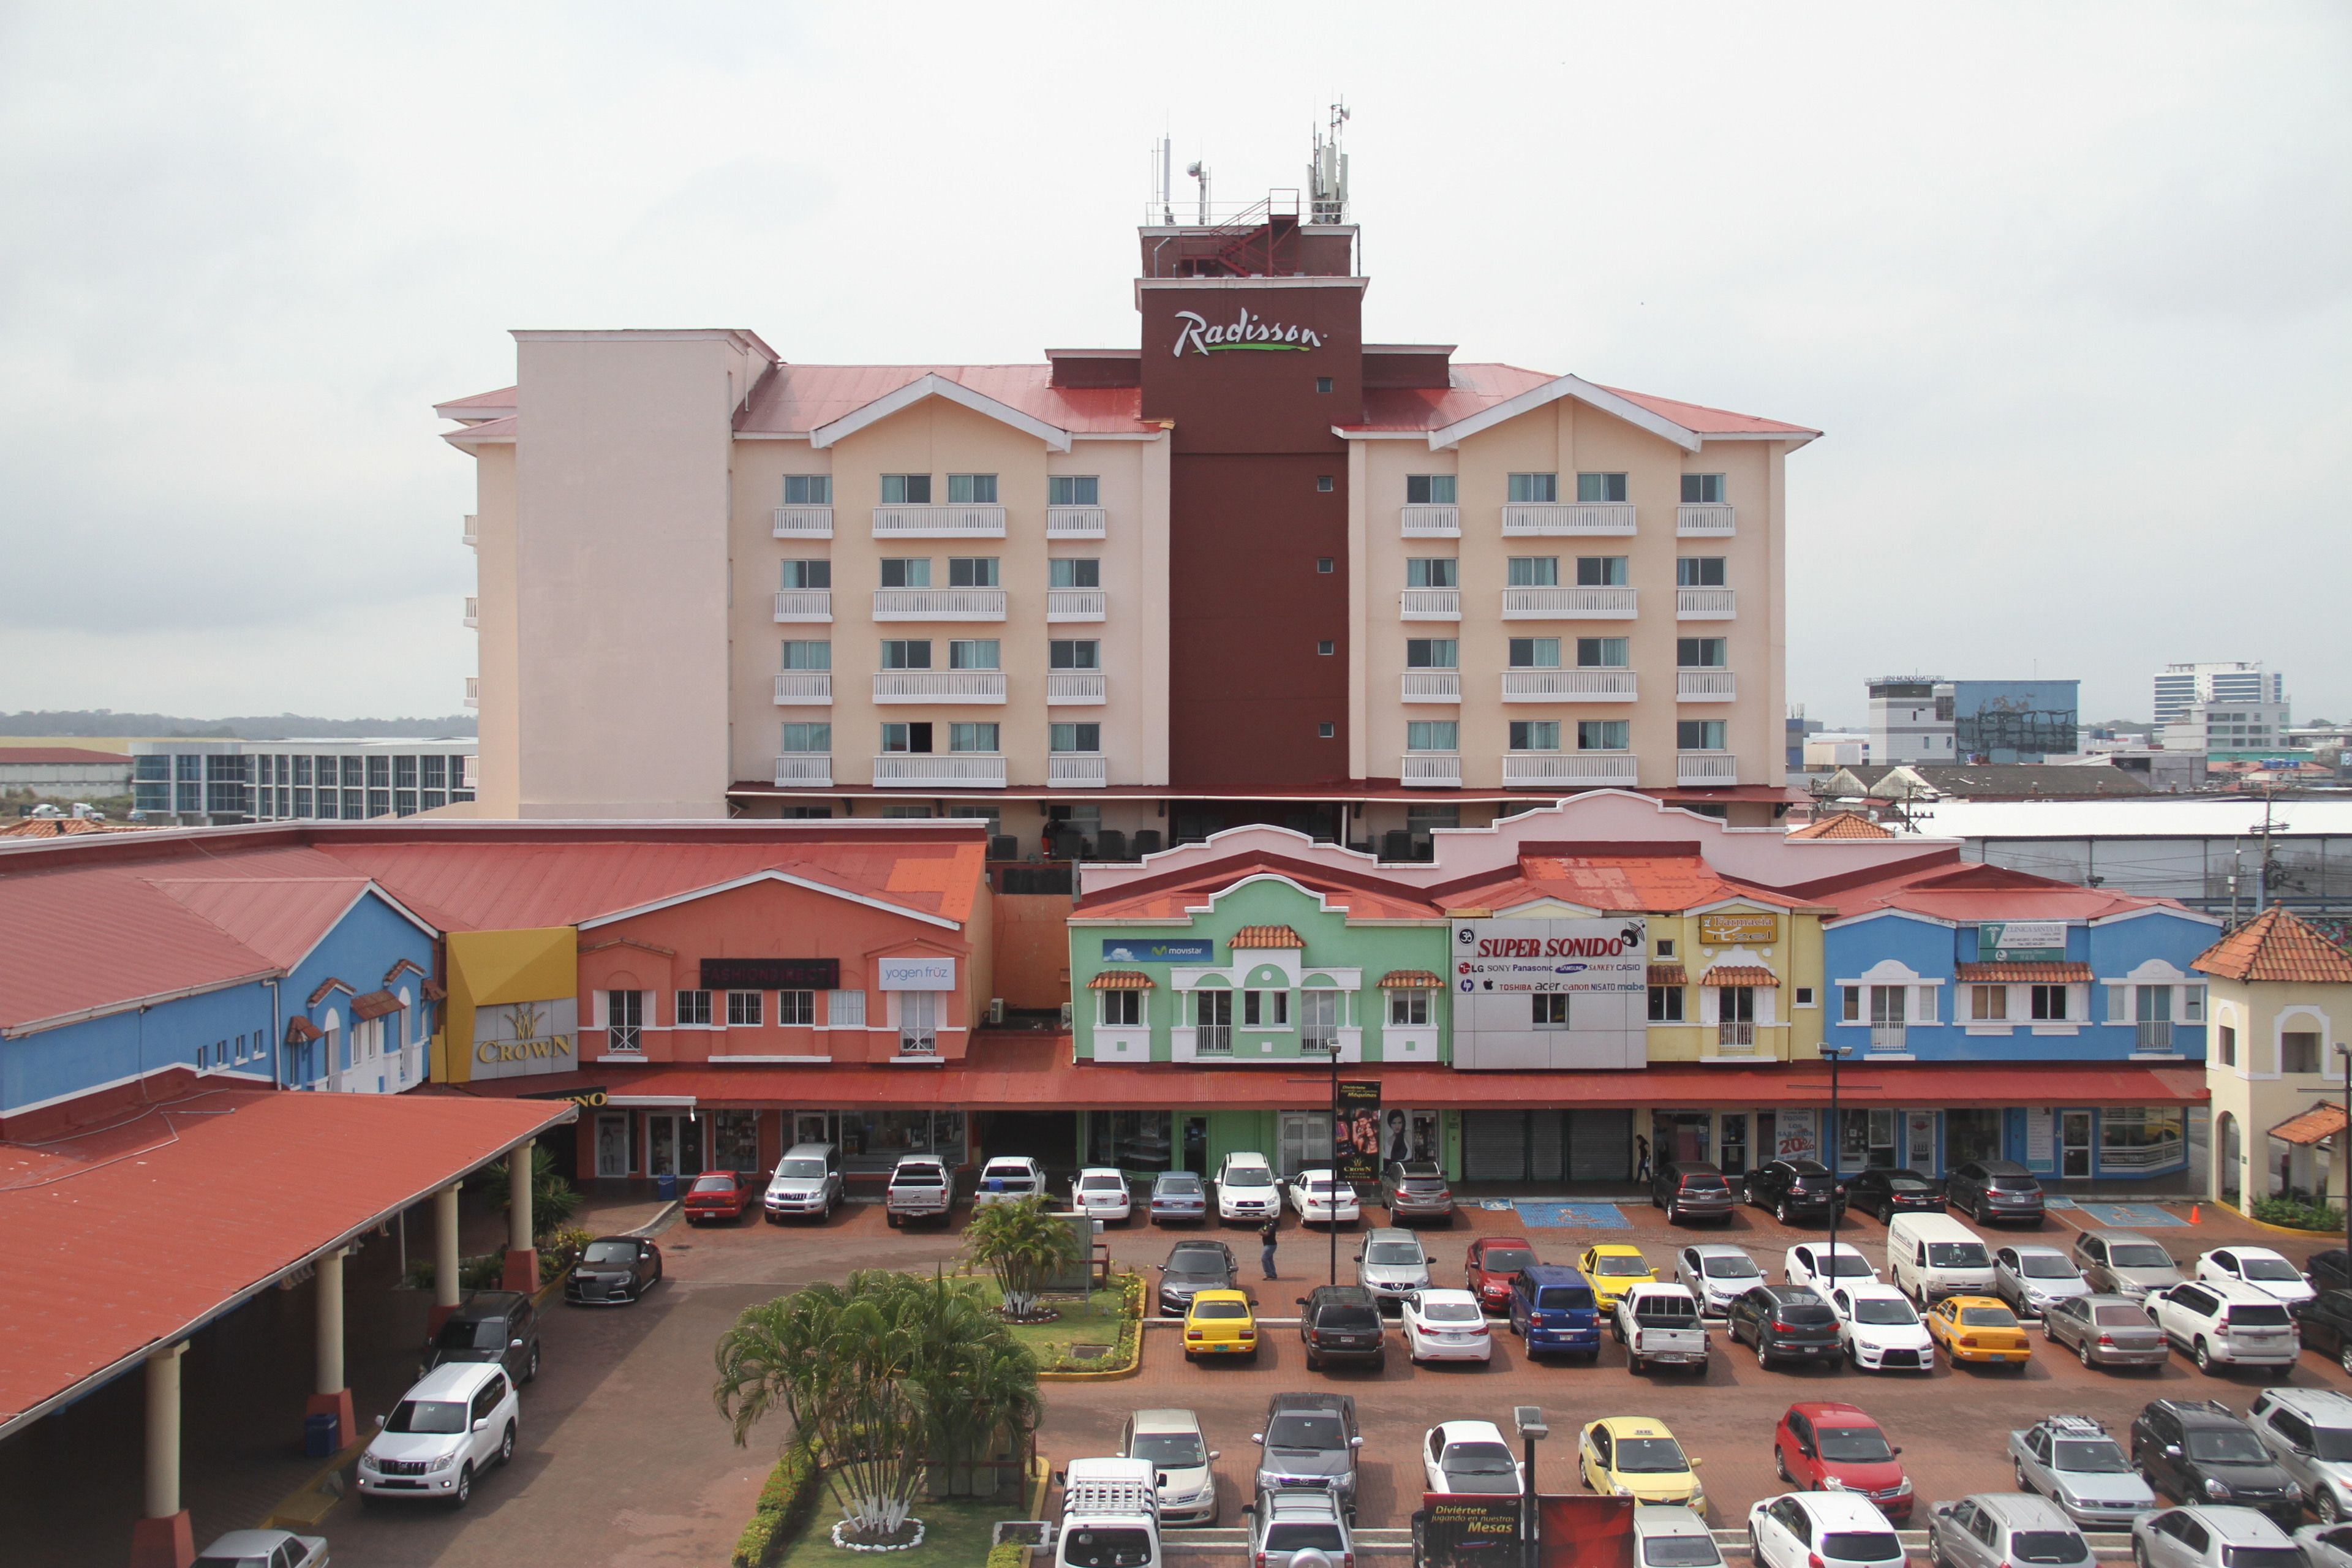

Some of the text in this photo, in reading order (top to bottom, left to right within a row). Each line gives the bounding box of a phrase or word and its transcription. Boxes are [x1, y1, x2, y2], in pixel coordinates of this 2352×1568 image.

[1173, 307, 1321, 357] Radisson
[1714, 916, 1773, 927] Farmacia
[1477, 937, 1623, 958] SUPER SONIDO
[886, 966, 948, 980] yogen früz
[1535, 982, 1561, 991] acer
[1617, 982, 1645, 991] mabe
[478, 1034, 572, 1064] CROWN
[1779, 1137, 1814, 1155] 20%
[1435, 1506, 1487, 1514] Diviértete
[1467, 1521, 1513, 1533] Mesas
